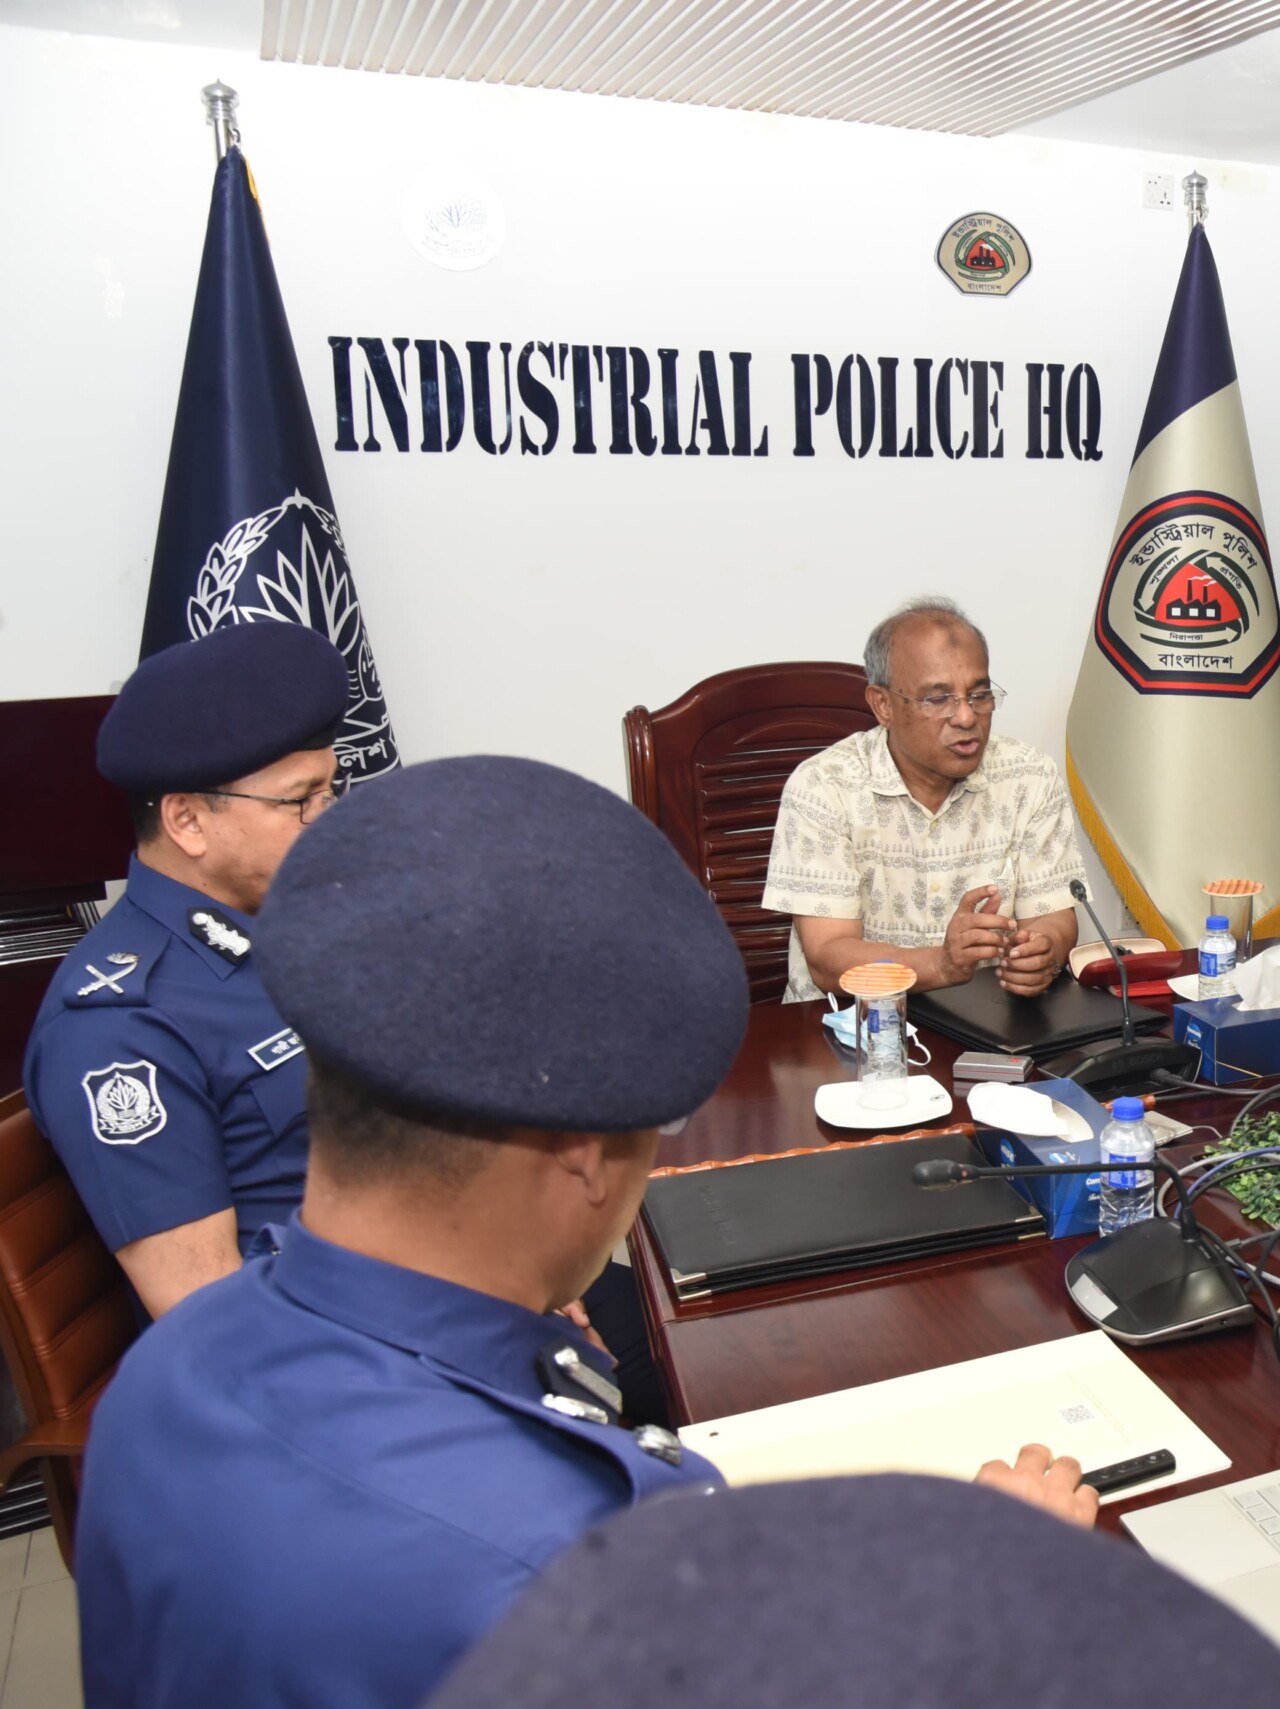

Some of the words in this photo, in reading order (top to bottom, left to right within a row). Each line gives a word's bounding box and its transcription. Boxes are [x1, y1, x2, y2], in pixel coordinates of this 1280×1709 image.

[967, 283, 1002, 291] বাংলাদেশ
[327, 336, 768, 457] INDUSTRIAL
[791, 354, 1004, 459] POLICE
[1026, 363, 1103, 462] HQ
[1129, 522, 1216, 567] ইন্ডাস্ট্রিয়াল
[1222, 531, 1258, 570] পুলিশ
[1218, 566, 1244, 590] প্রগতি
[1158, 653, 1234, 670] বাংলাদেশ
